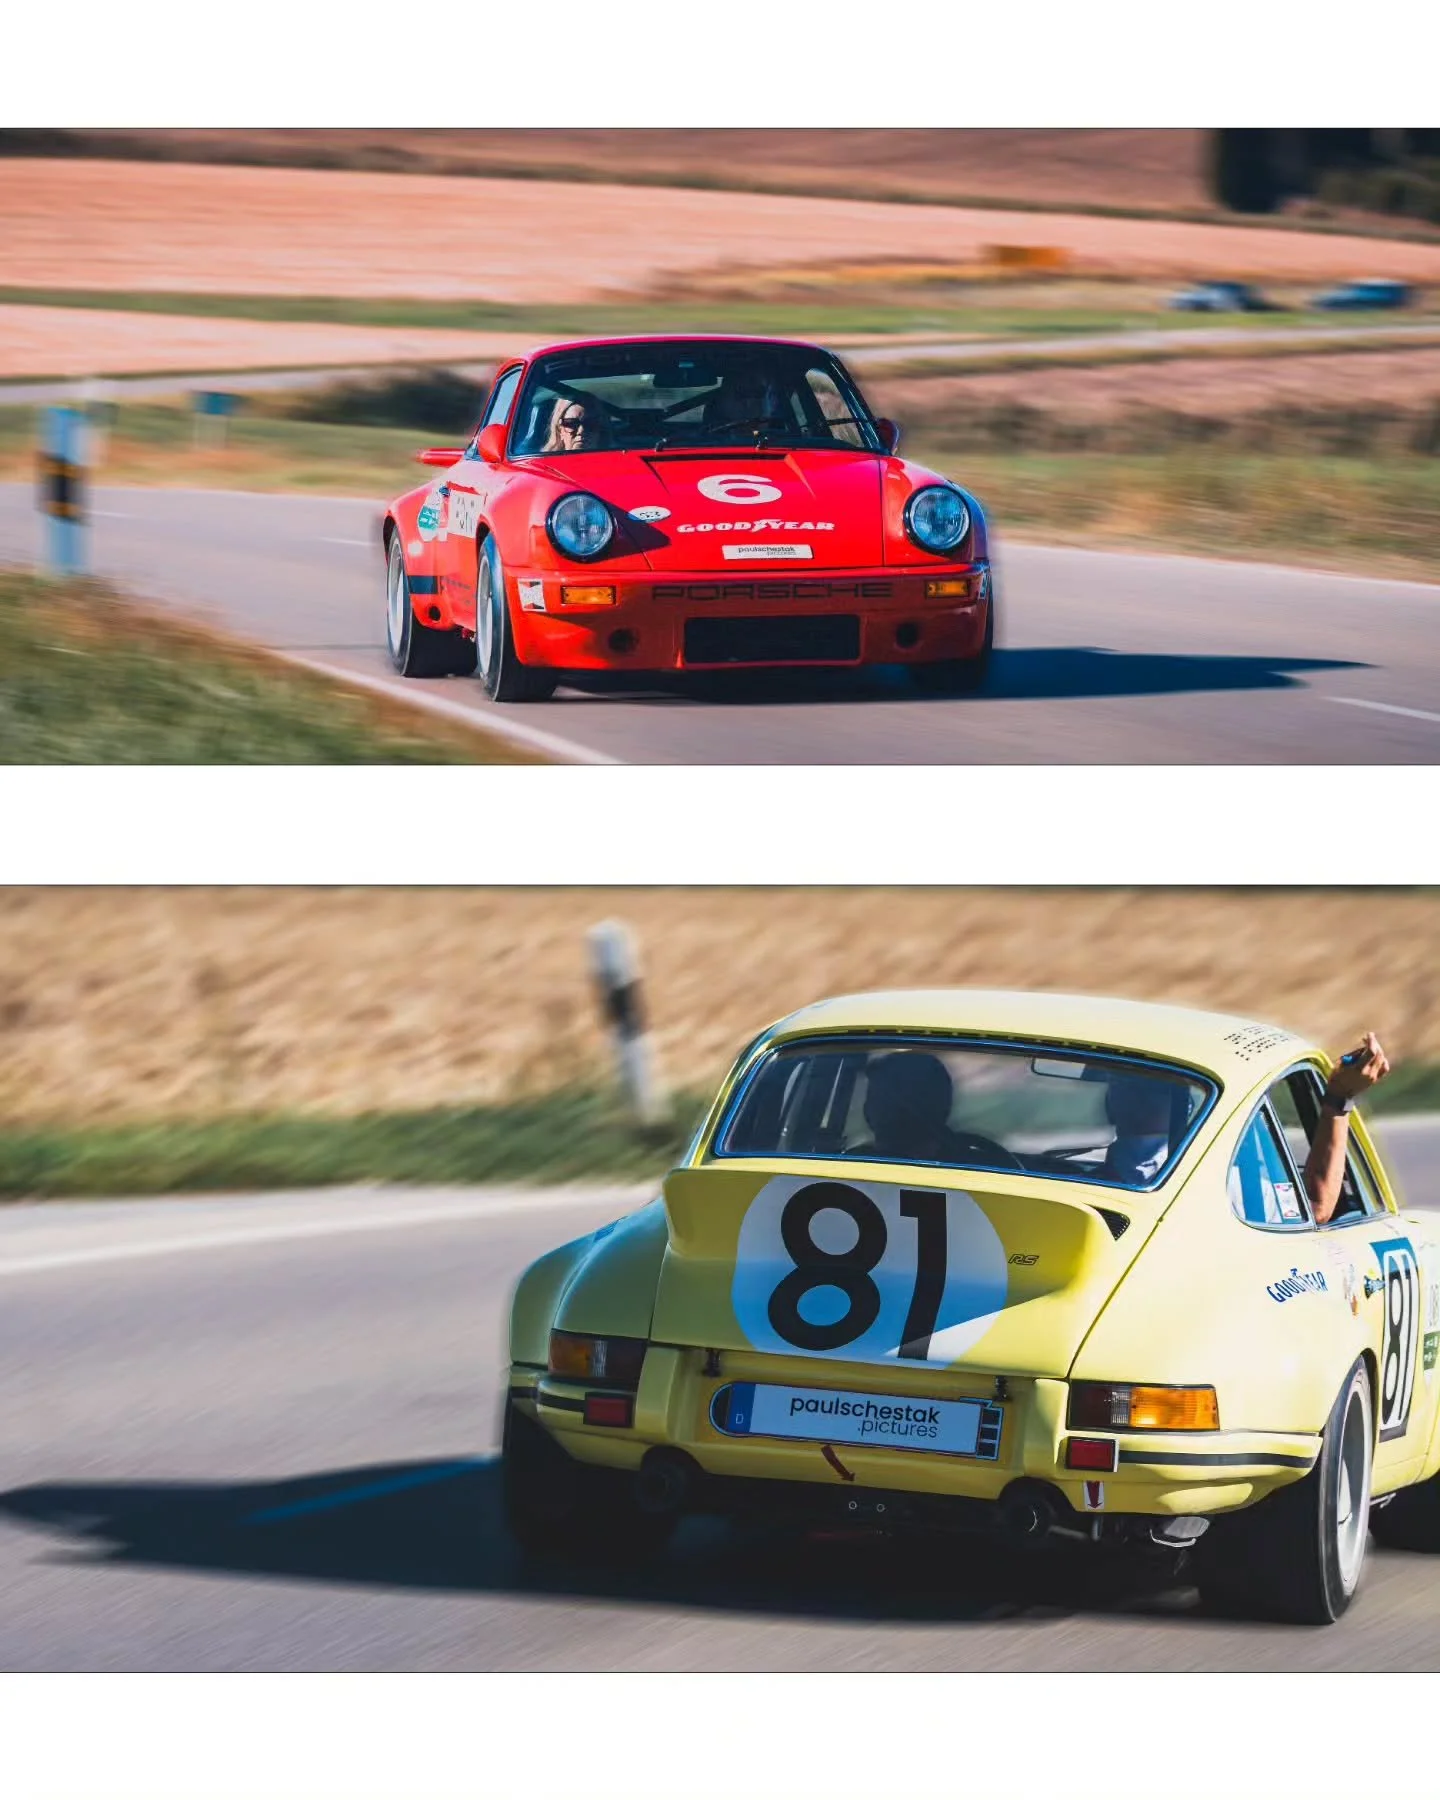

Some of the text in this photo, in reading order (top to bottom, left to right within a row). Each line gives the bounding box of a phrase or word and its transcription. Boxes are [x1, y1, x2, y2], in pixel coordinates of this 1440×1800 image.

[697, 474, 783, 505] 6
[677, 518, 836, 534] GOODYEAR
[652, 583, 894, 601] PORSCHE
[1008, 1253, 1040, 1266] RS
[768, 1182, 948, 1361] 81
[1382, 1253, 1413, 1426] 81
[735, 1413, 744, 1425] D
[790, 1396, 941, 1425] paulschestak
[857, 1418, 938, 1439] .pictures
